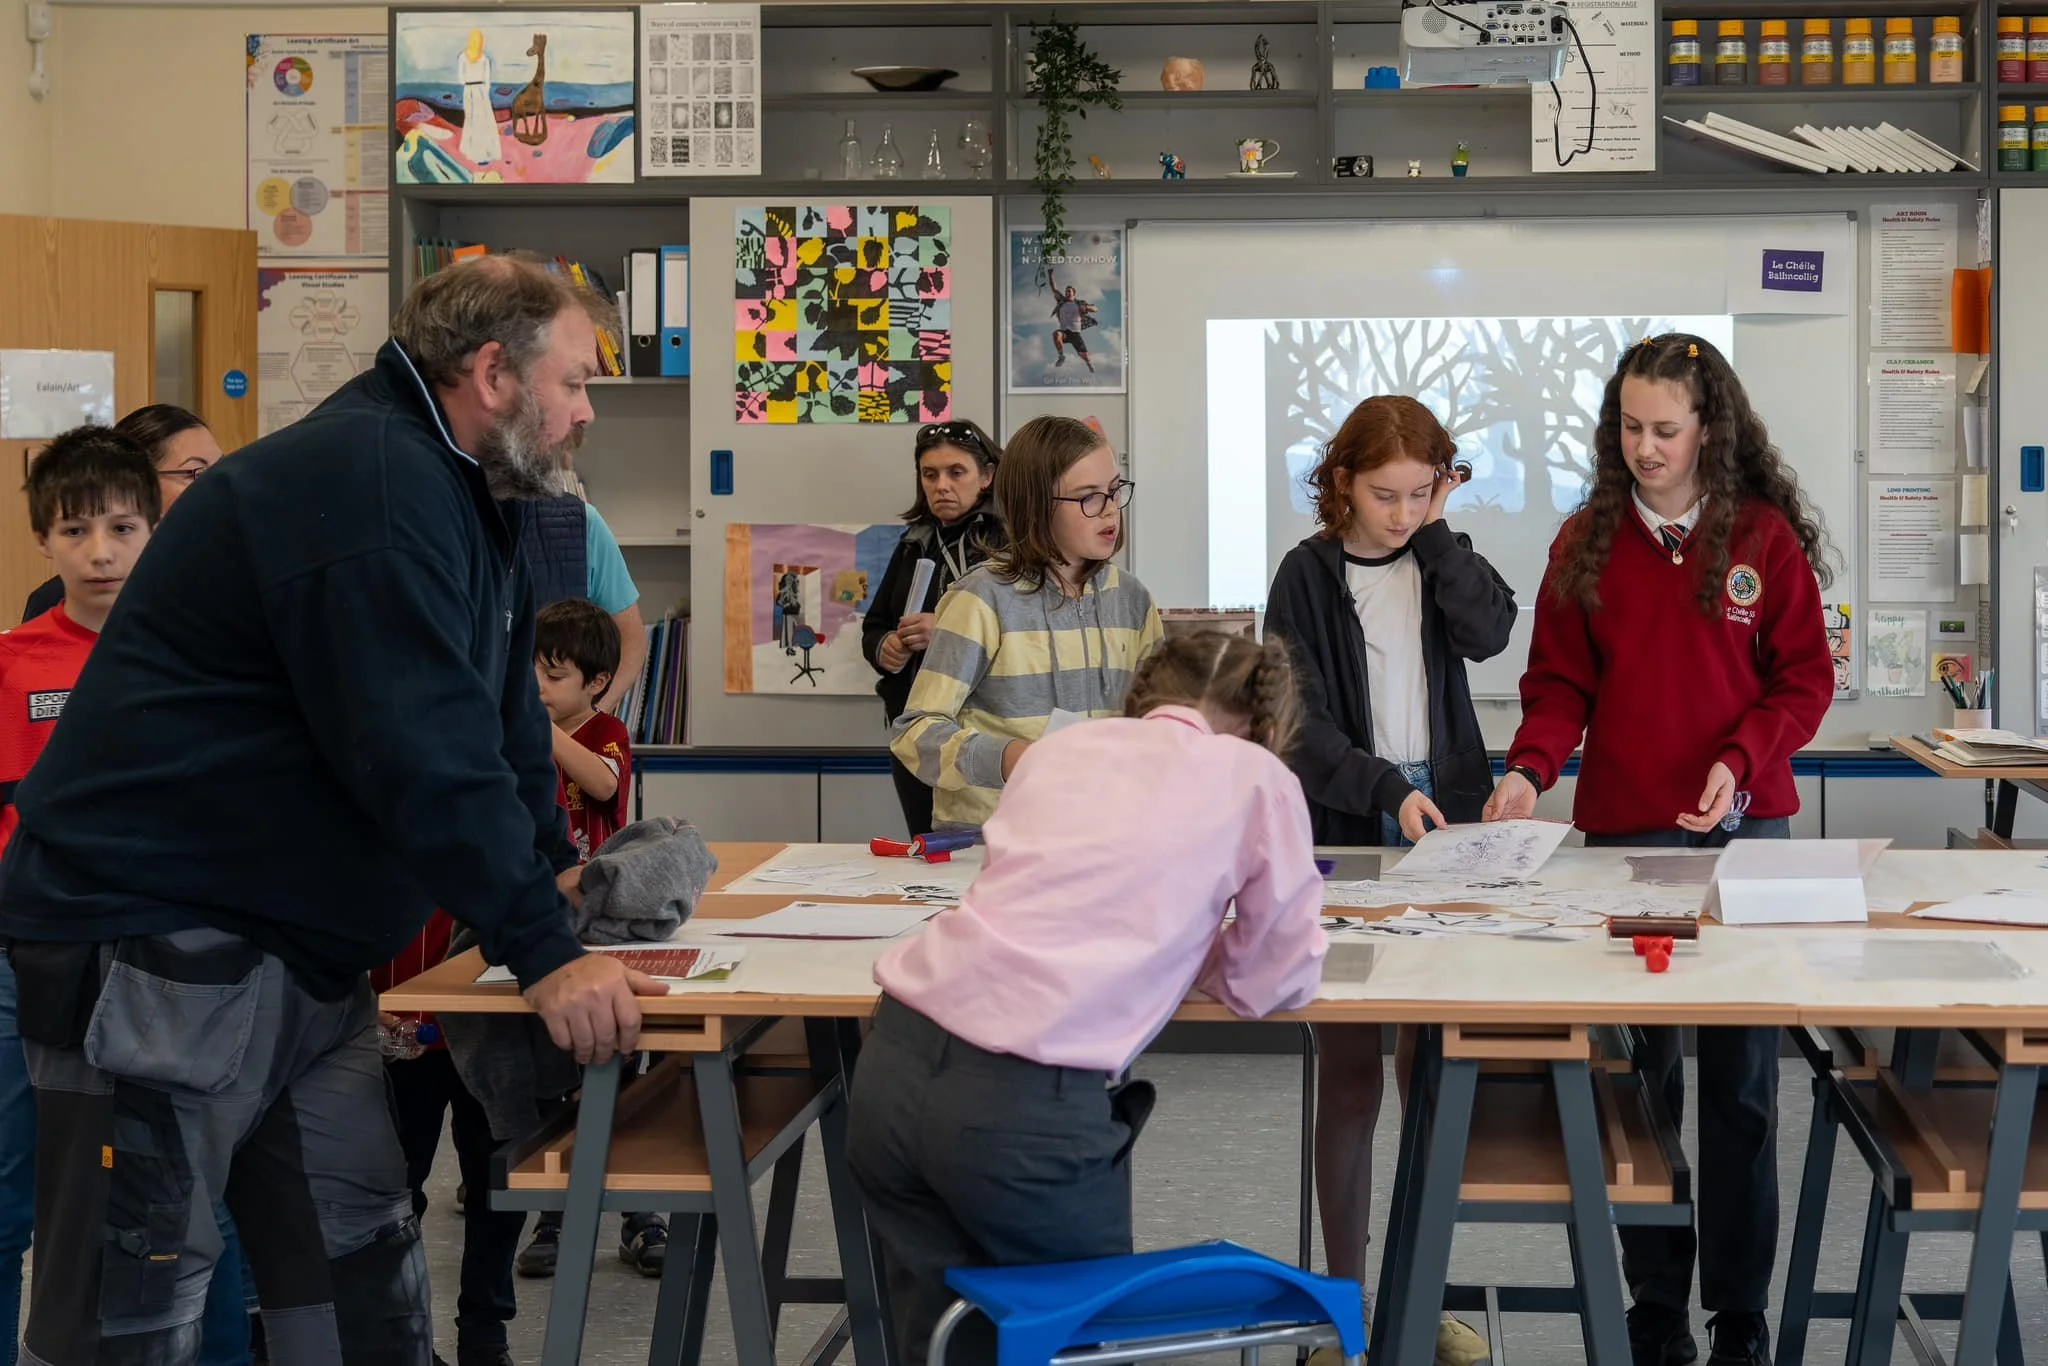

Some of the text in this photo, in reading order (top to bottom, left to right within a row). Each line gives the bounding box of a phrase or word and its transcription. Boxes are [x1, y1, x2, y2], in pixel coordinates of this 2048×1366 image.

[1066, 256, 1081, 264] TO
[1083, 256, 1117, 264] KNOW
[1772, 260, 1816, 271] Le Chéile
[1768, 271, 1819, 283] Ballincollig
[1875, 613, 1905, 626] happy
